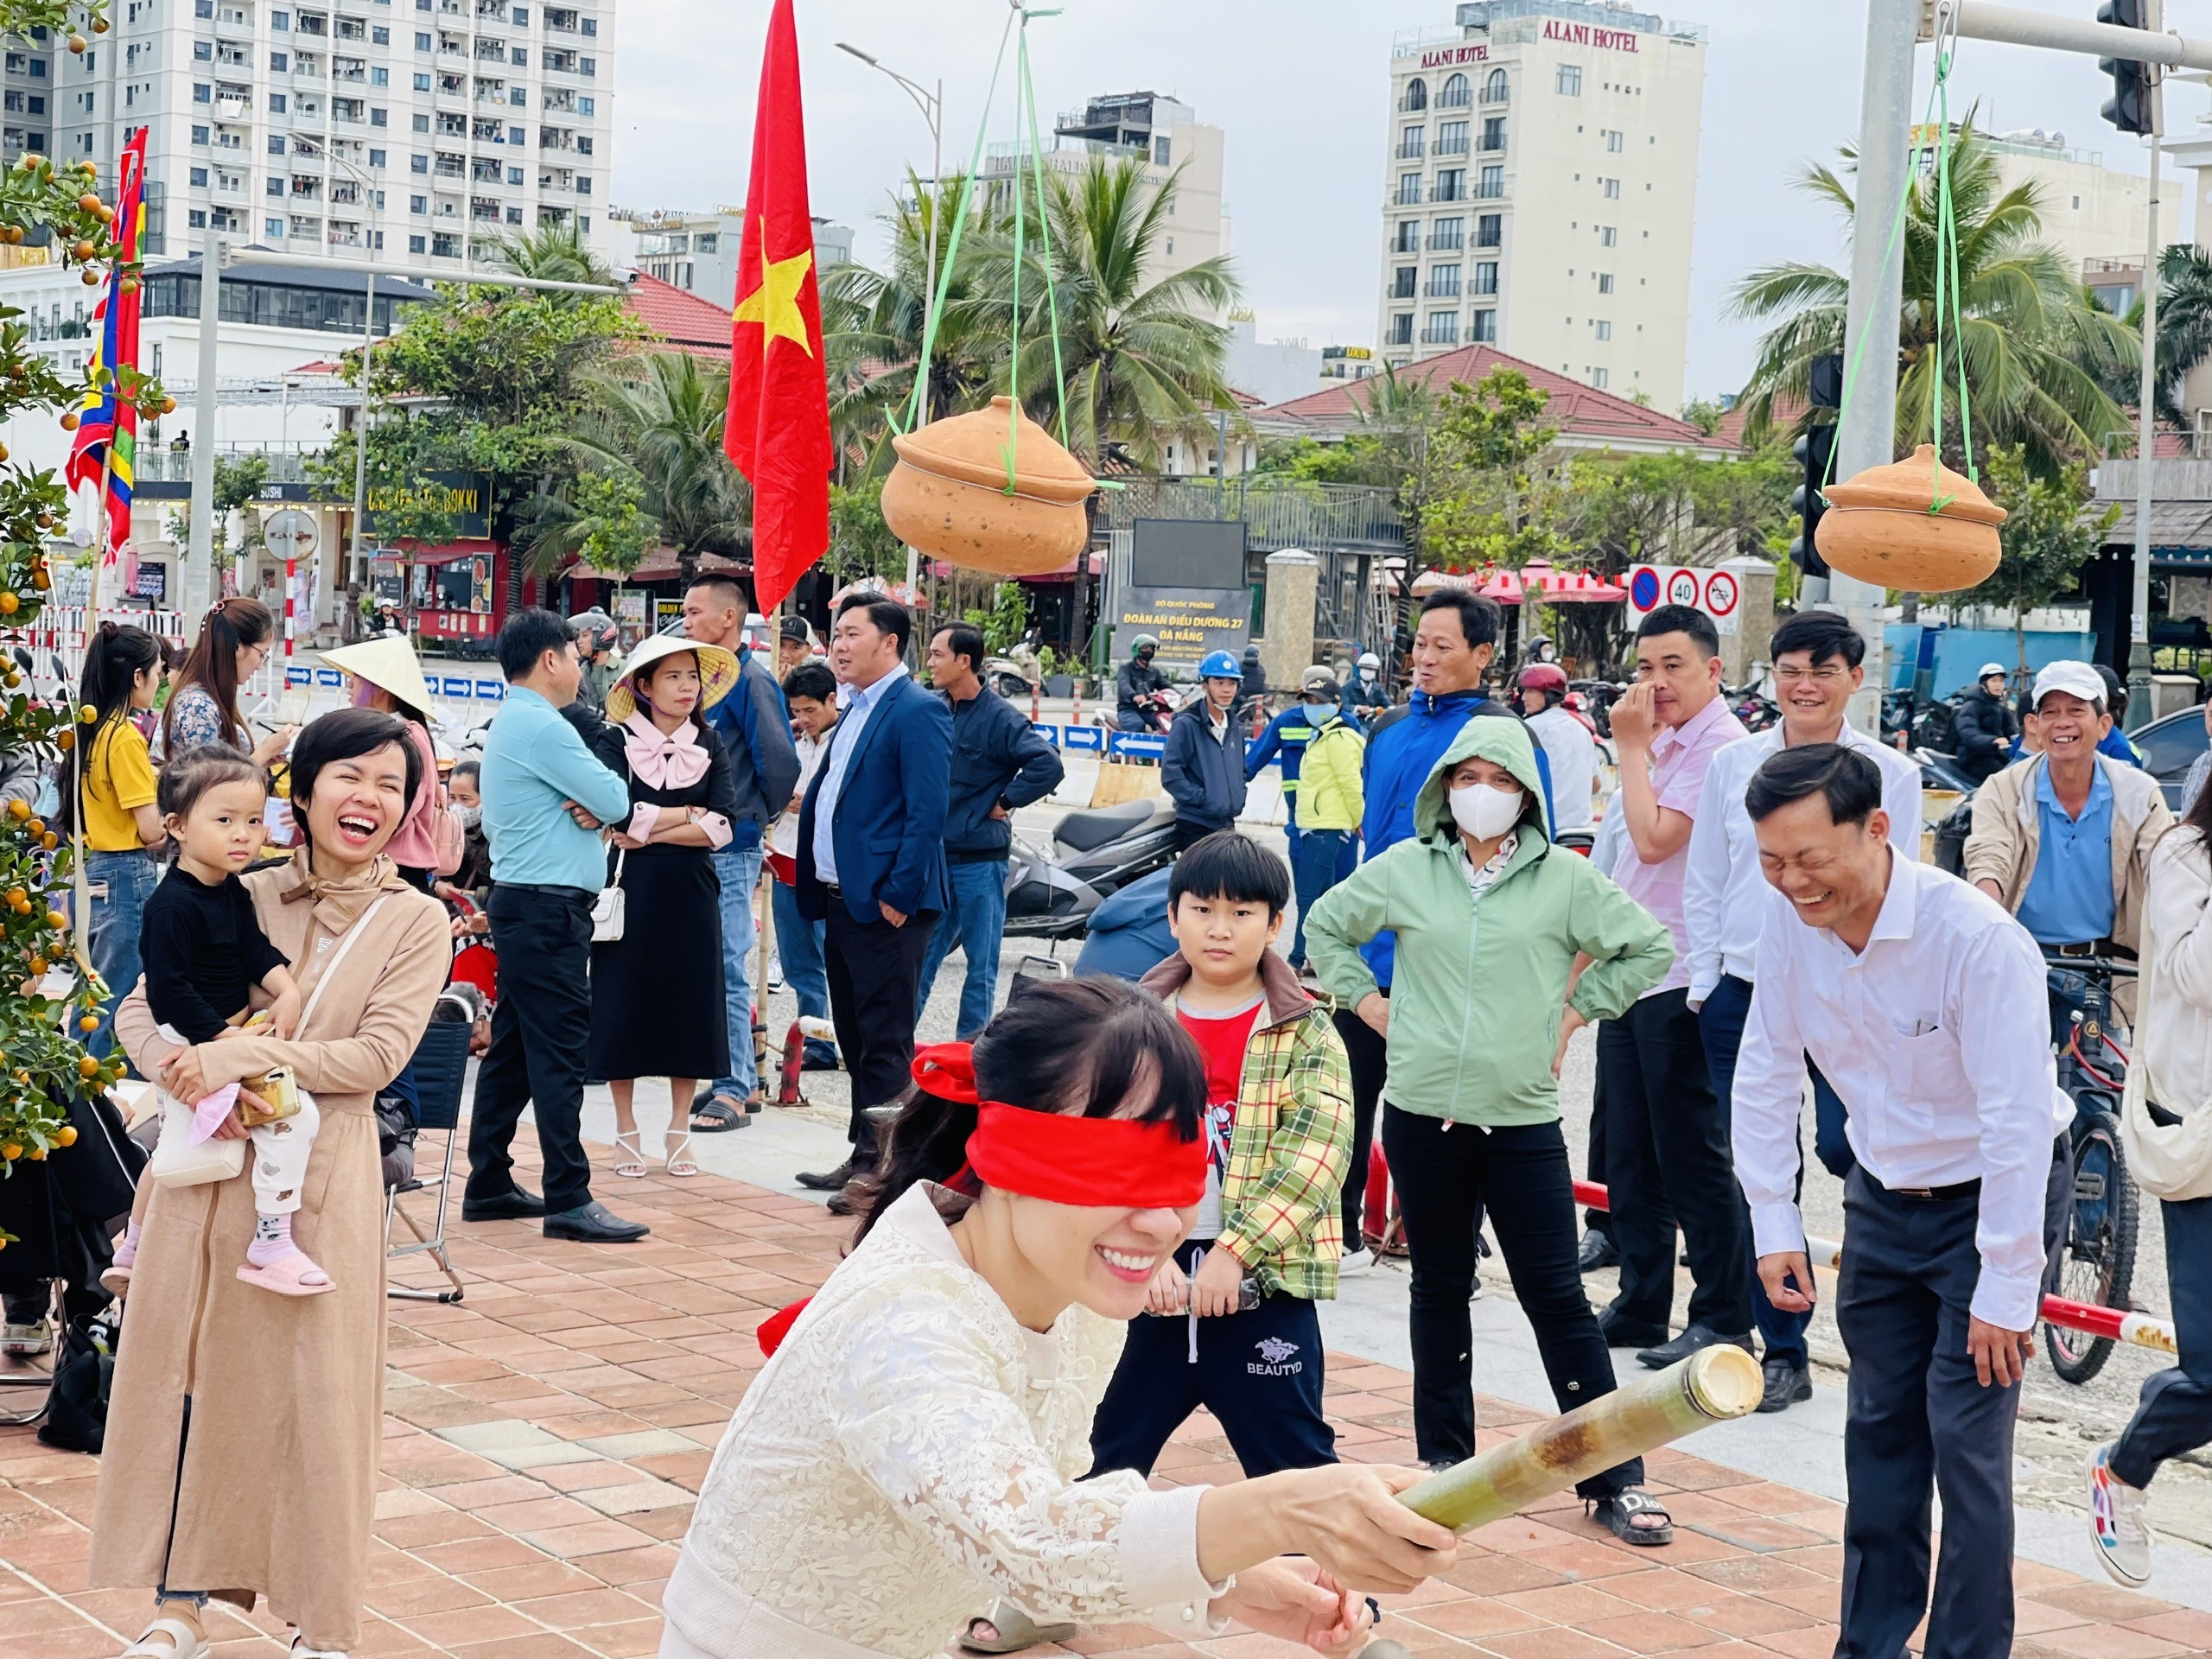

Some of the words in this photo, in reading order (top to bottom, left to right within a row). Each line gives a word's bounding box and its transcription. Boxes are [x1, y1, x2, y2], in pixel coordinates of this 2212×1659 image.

[1543, 20, 1590, 45] ALANI
[1593, 29, 1638, 54] HOTEL
[1421, 49, 1453, 69] ALANI
[1456, 45, 1490, 64] HOTEL
[1346, 347, 1368, 359] LOUIS
[260, 486, 283, 499] SUSHI
[1675, 583, 1691, 601] 40
[1230, 619, 1244, 629] 27
